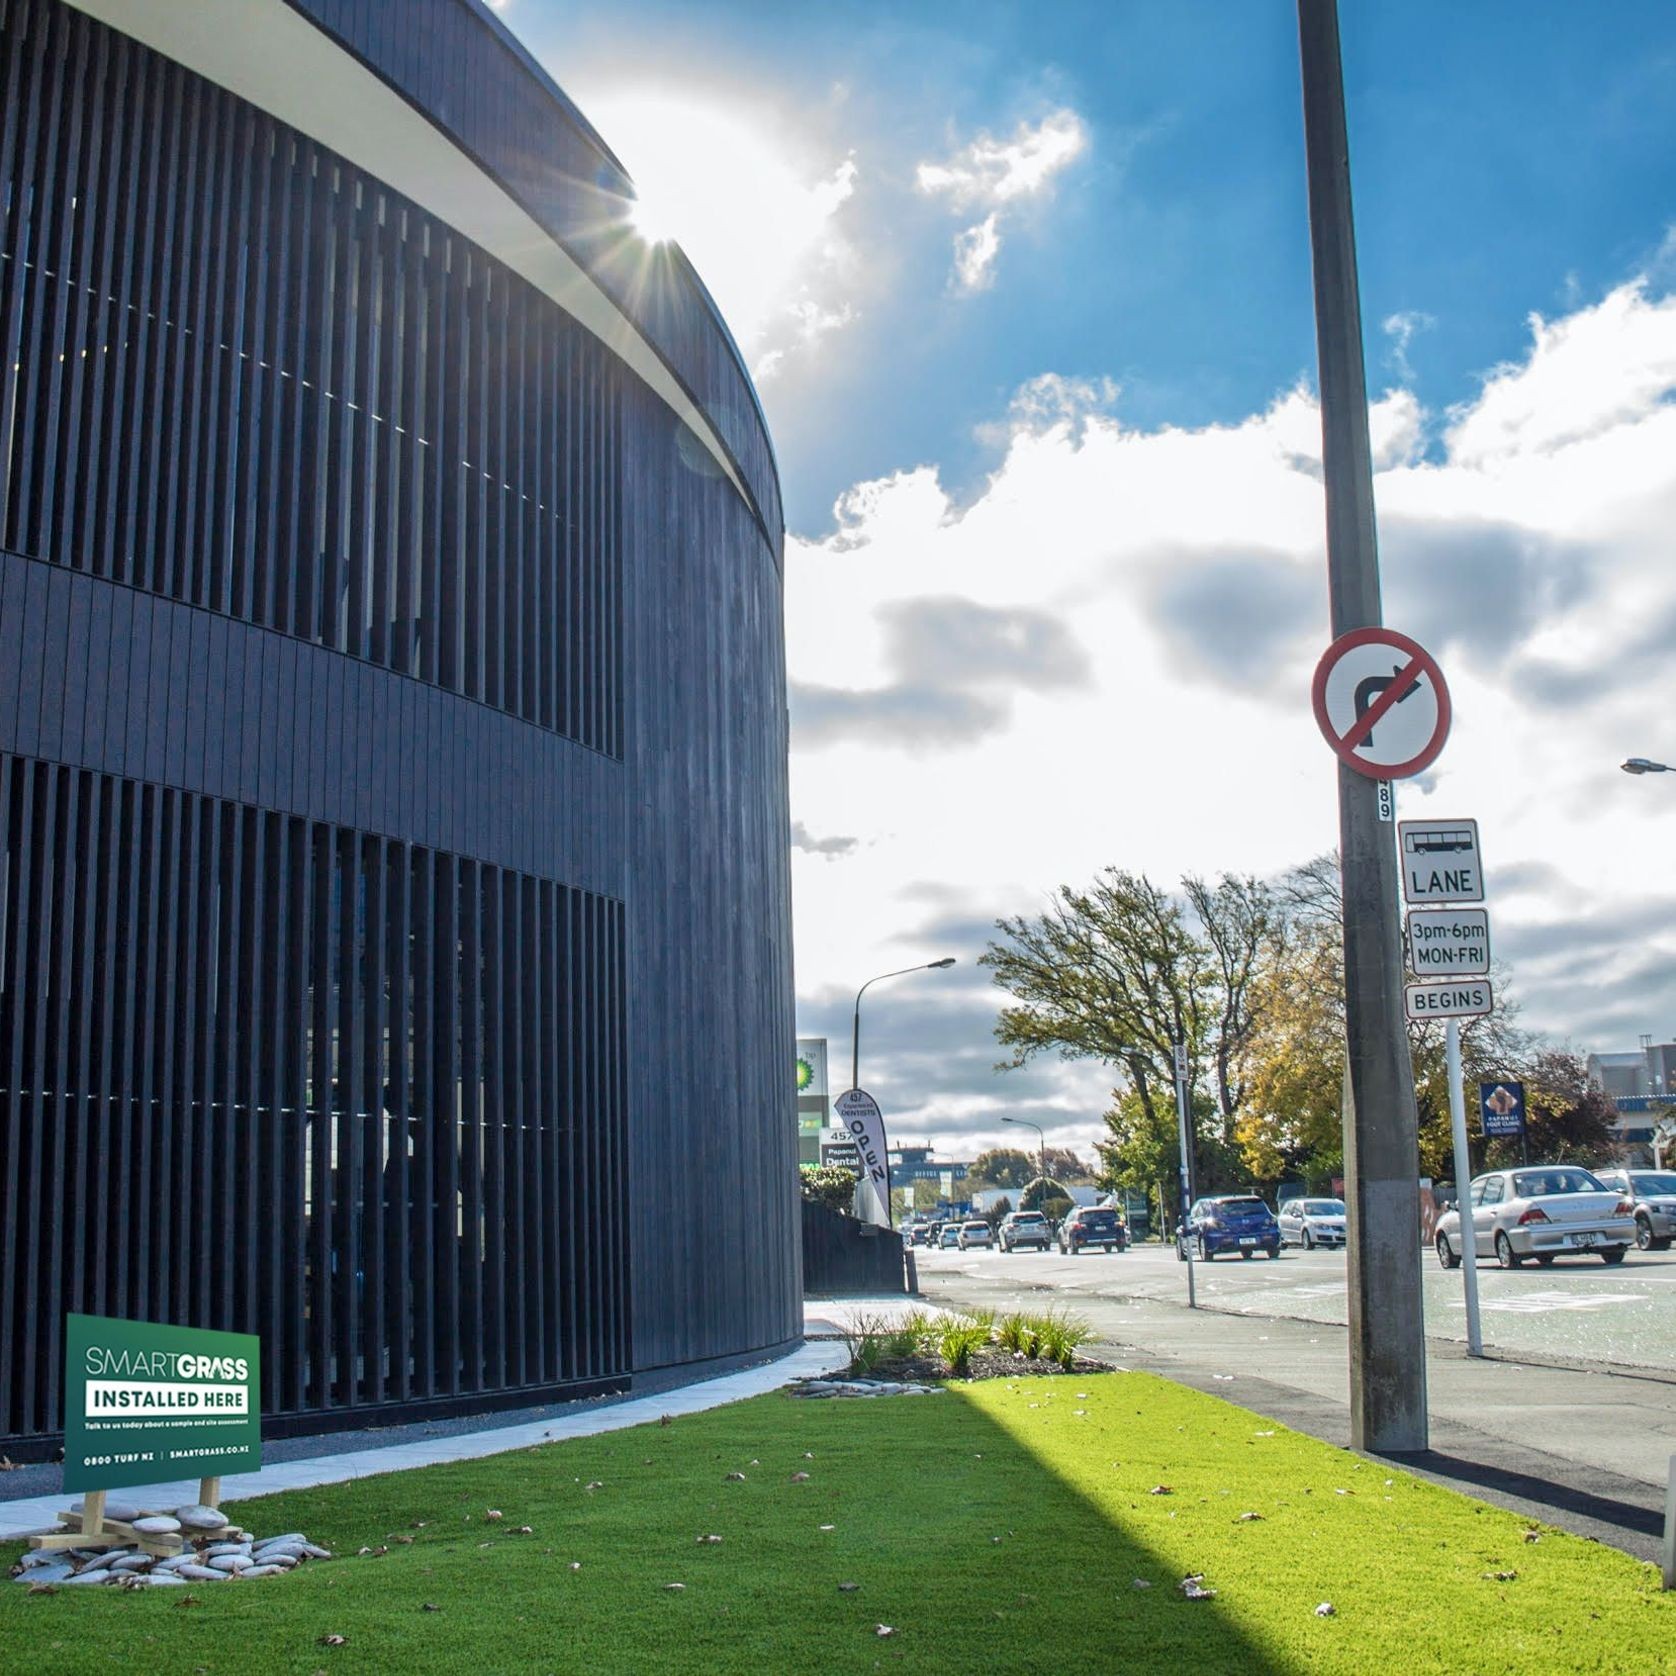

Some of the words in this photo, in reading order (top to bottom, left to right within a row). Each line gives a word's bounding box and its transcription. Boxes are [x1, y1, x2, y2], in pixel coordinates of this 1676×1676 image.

[1412, 870, 1473, 893] LANE
[1413, 923, 1485, 942] 3pm-6pm
[1418, 947, 1483, 964] MON-FRI
[1415, 990, 1484, 1010] BEGINS
[850, 1120, 886, 1183] OPEN
[826, 1157, 859, 1166] Dental
[86, 1347, 248, 1381] SMARTGRASS
[94, 1390, 198, 1408] INSTALLED
[204, 1392, 243, 1407] HERE
[85, 1422, 101, 1430] Talk
[122, 1422, 143, 1430] today
[83, 1455, 111, 1466] 0800
[114, 1453, 139, 1463] TURF
[141, 1452, 154, 1461] NZ
